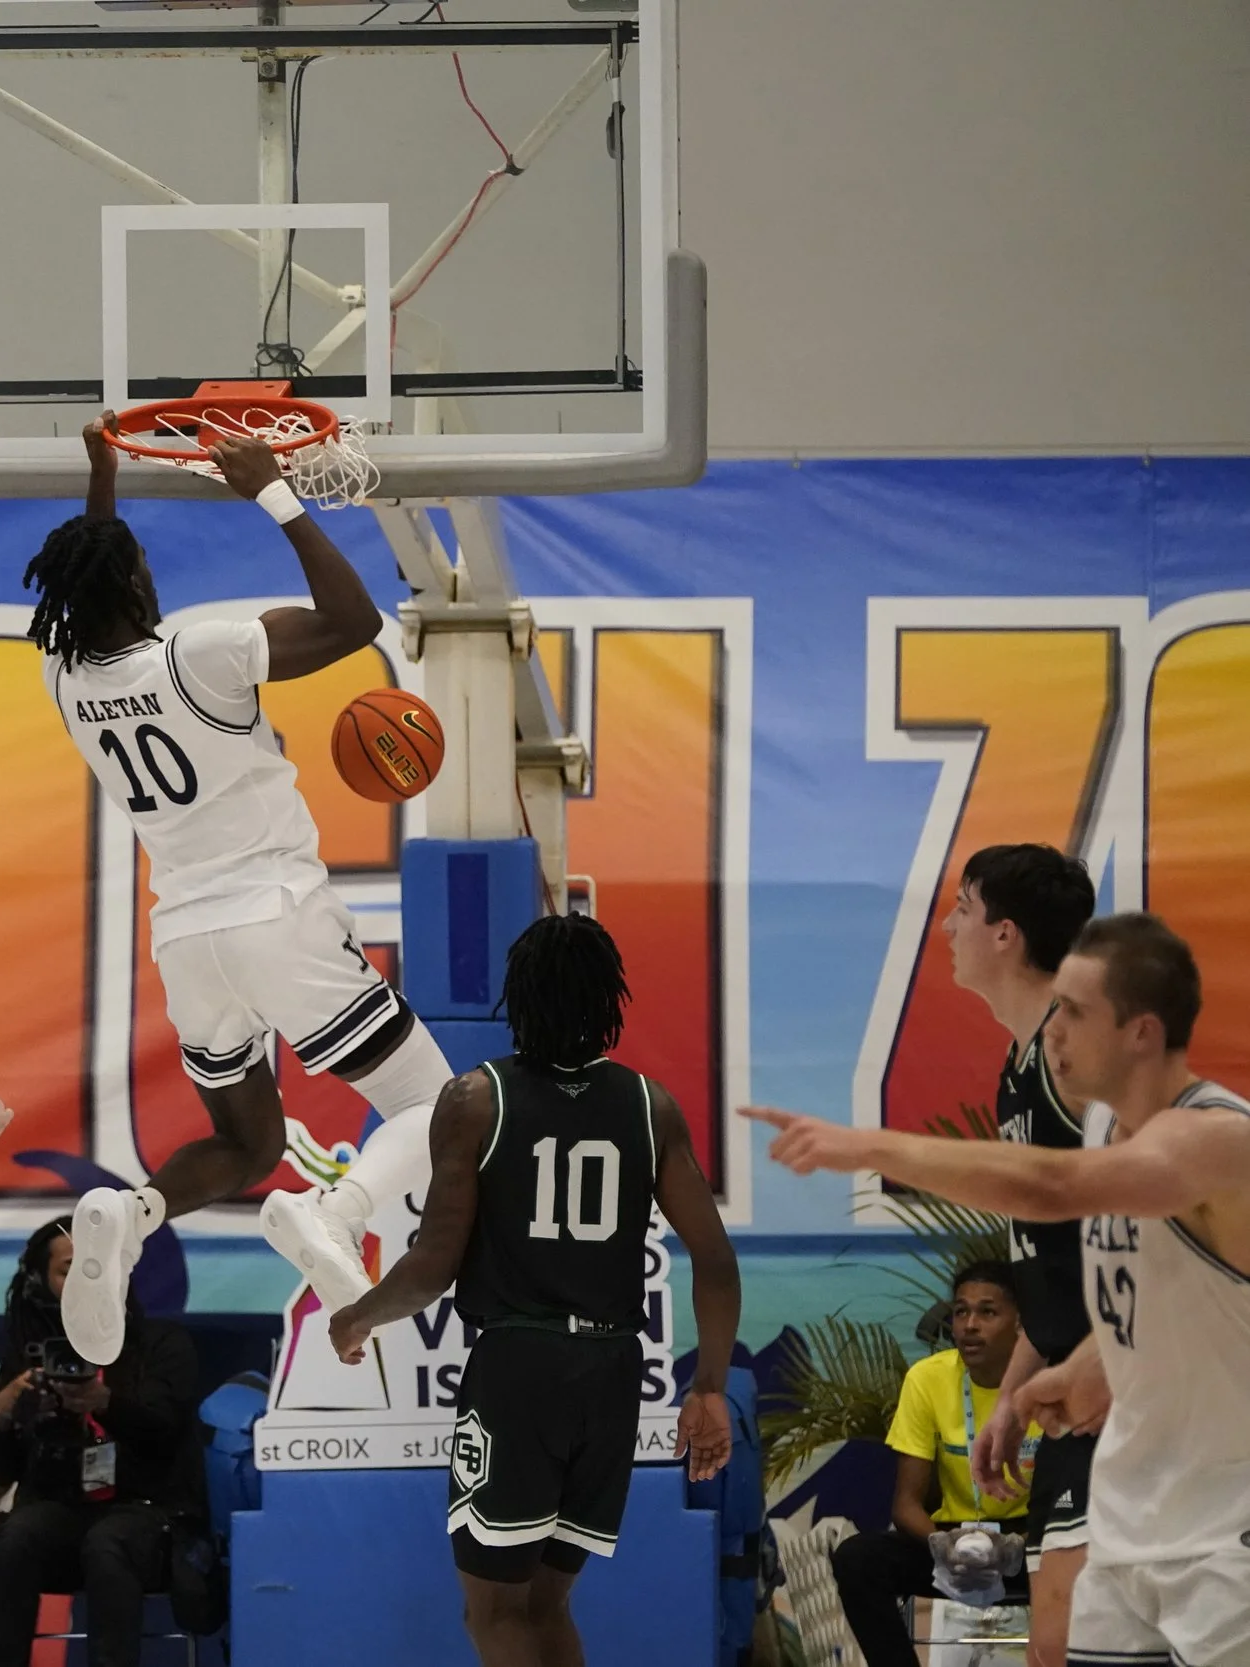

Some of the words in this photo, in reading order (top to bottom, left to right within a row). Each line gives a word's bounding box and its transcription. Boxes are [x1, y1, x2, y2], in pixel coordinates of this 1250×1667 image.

[76, 692, 164, 723] ALETAN
[99, 723, 198, 813] 10
[376, 731, 420, 786] ELITE
[529, 1136, 620, 1242] 10
[261, 1445, 281, 1462] st
[288, 1437, 370, 1461] CROIX
[403, 1440, 423, 1458] st
